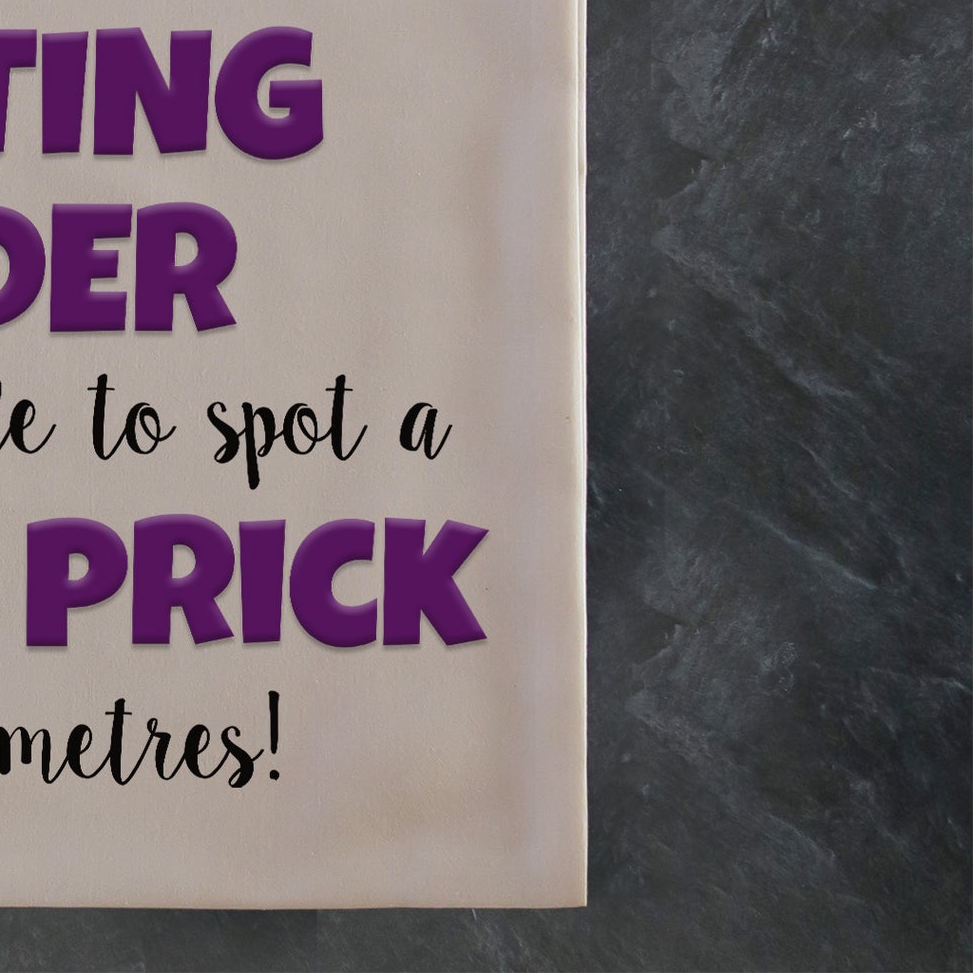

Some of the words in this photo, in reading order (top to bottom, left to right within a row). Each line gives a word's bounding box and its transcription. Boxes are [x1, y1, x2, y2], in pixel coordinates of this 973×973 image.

[87, 373, 177, 461] to
[206, 374, 368, 491] spot
[399, 402, 453, 460] a
[26, 514, 489, 648] PRICK
